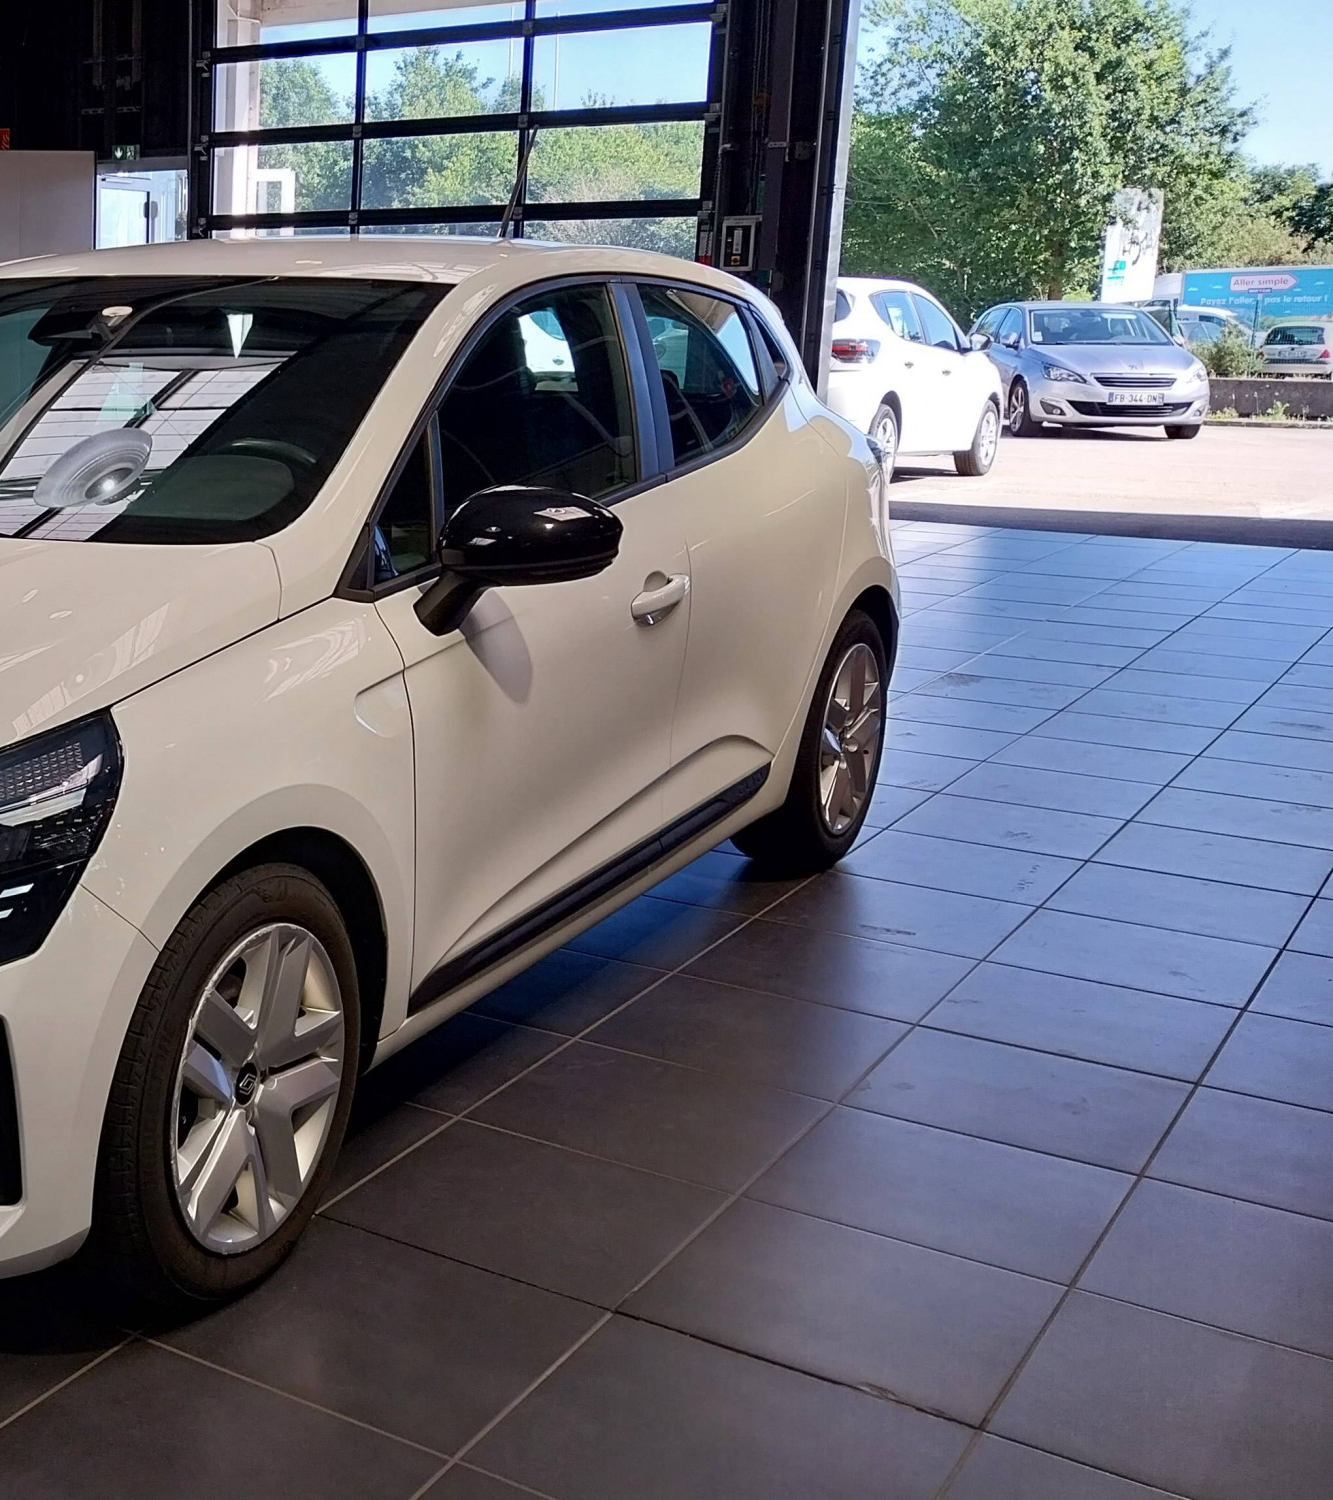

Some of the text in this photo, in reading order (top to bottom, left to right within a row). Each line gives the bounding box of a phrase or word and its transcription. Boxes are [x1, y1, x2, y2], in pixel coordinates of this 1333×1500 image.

[1233, 277, 1289, 287] Aller simple
[1200, 297, 1227, 306] Payez
[1264, 296, 1281, 305] pas
[1293, 294, 1322, 303] retour
